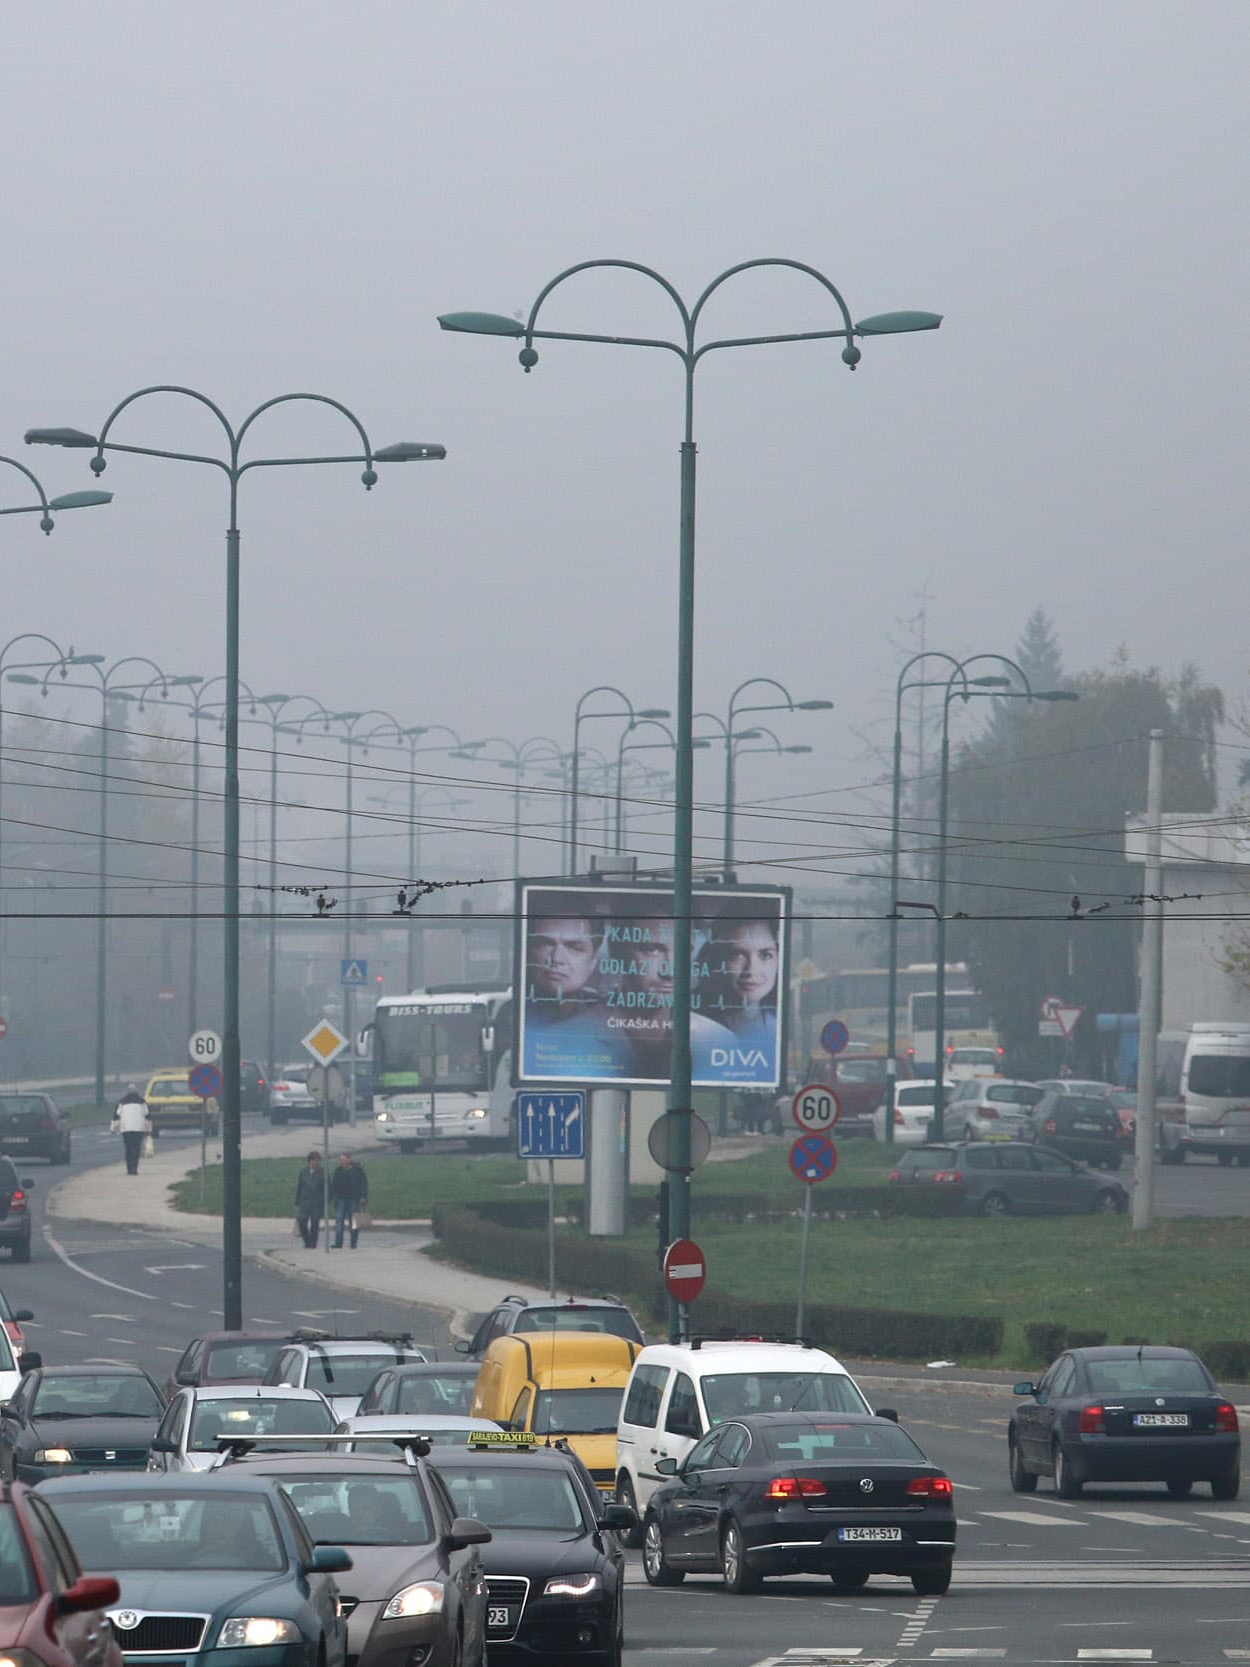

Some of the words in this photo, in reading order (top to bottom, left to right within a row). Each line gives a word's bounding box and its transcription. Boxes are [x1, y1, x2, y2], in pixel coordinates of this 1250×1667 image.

[611, 927, 652, 943] KADA
[196, 1037, 215, 1055] 60
[711, 1048, 769, 1068] DIVA
[803, 1096, 831, 1121] 60
[845, 1528, 900, 1540] T34-M-517
